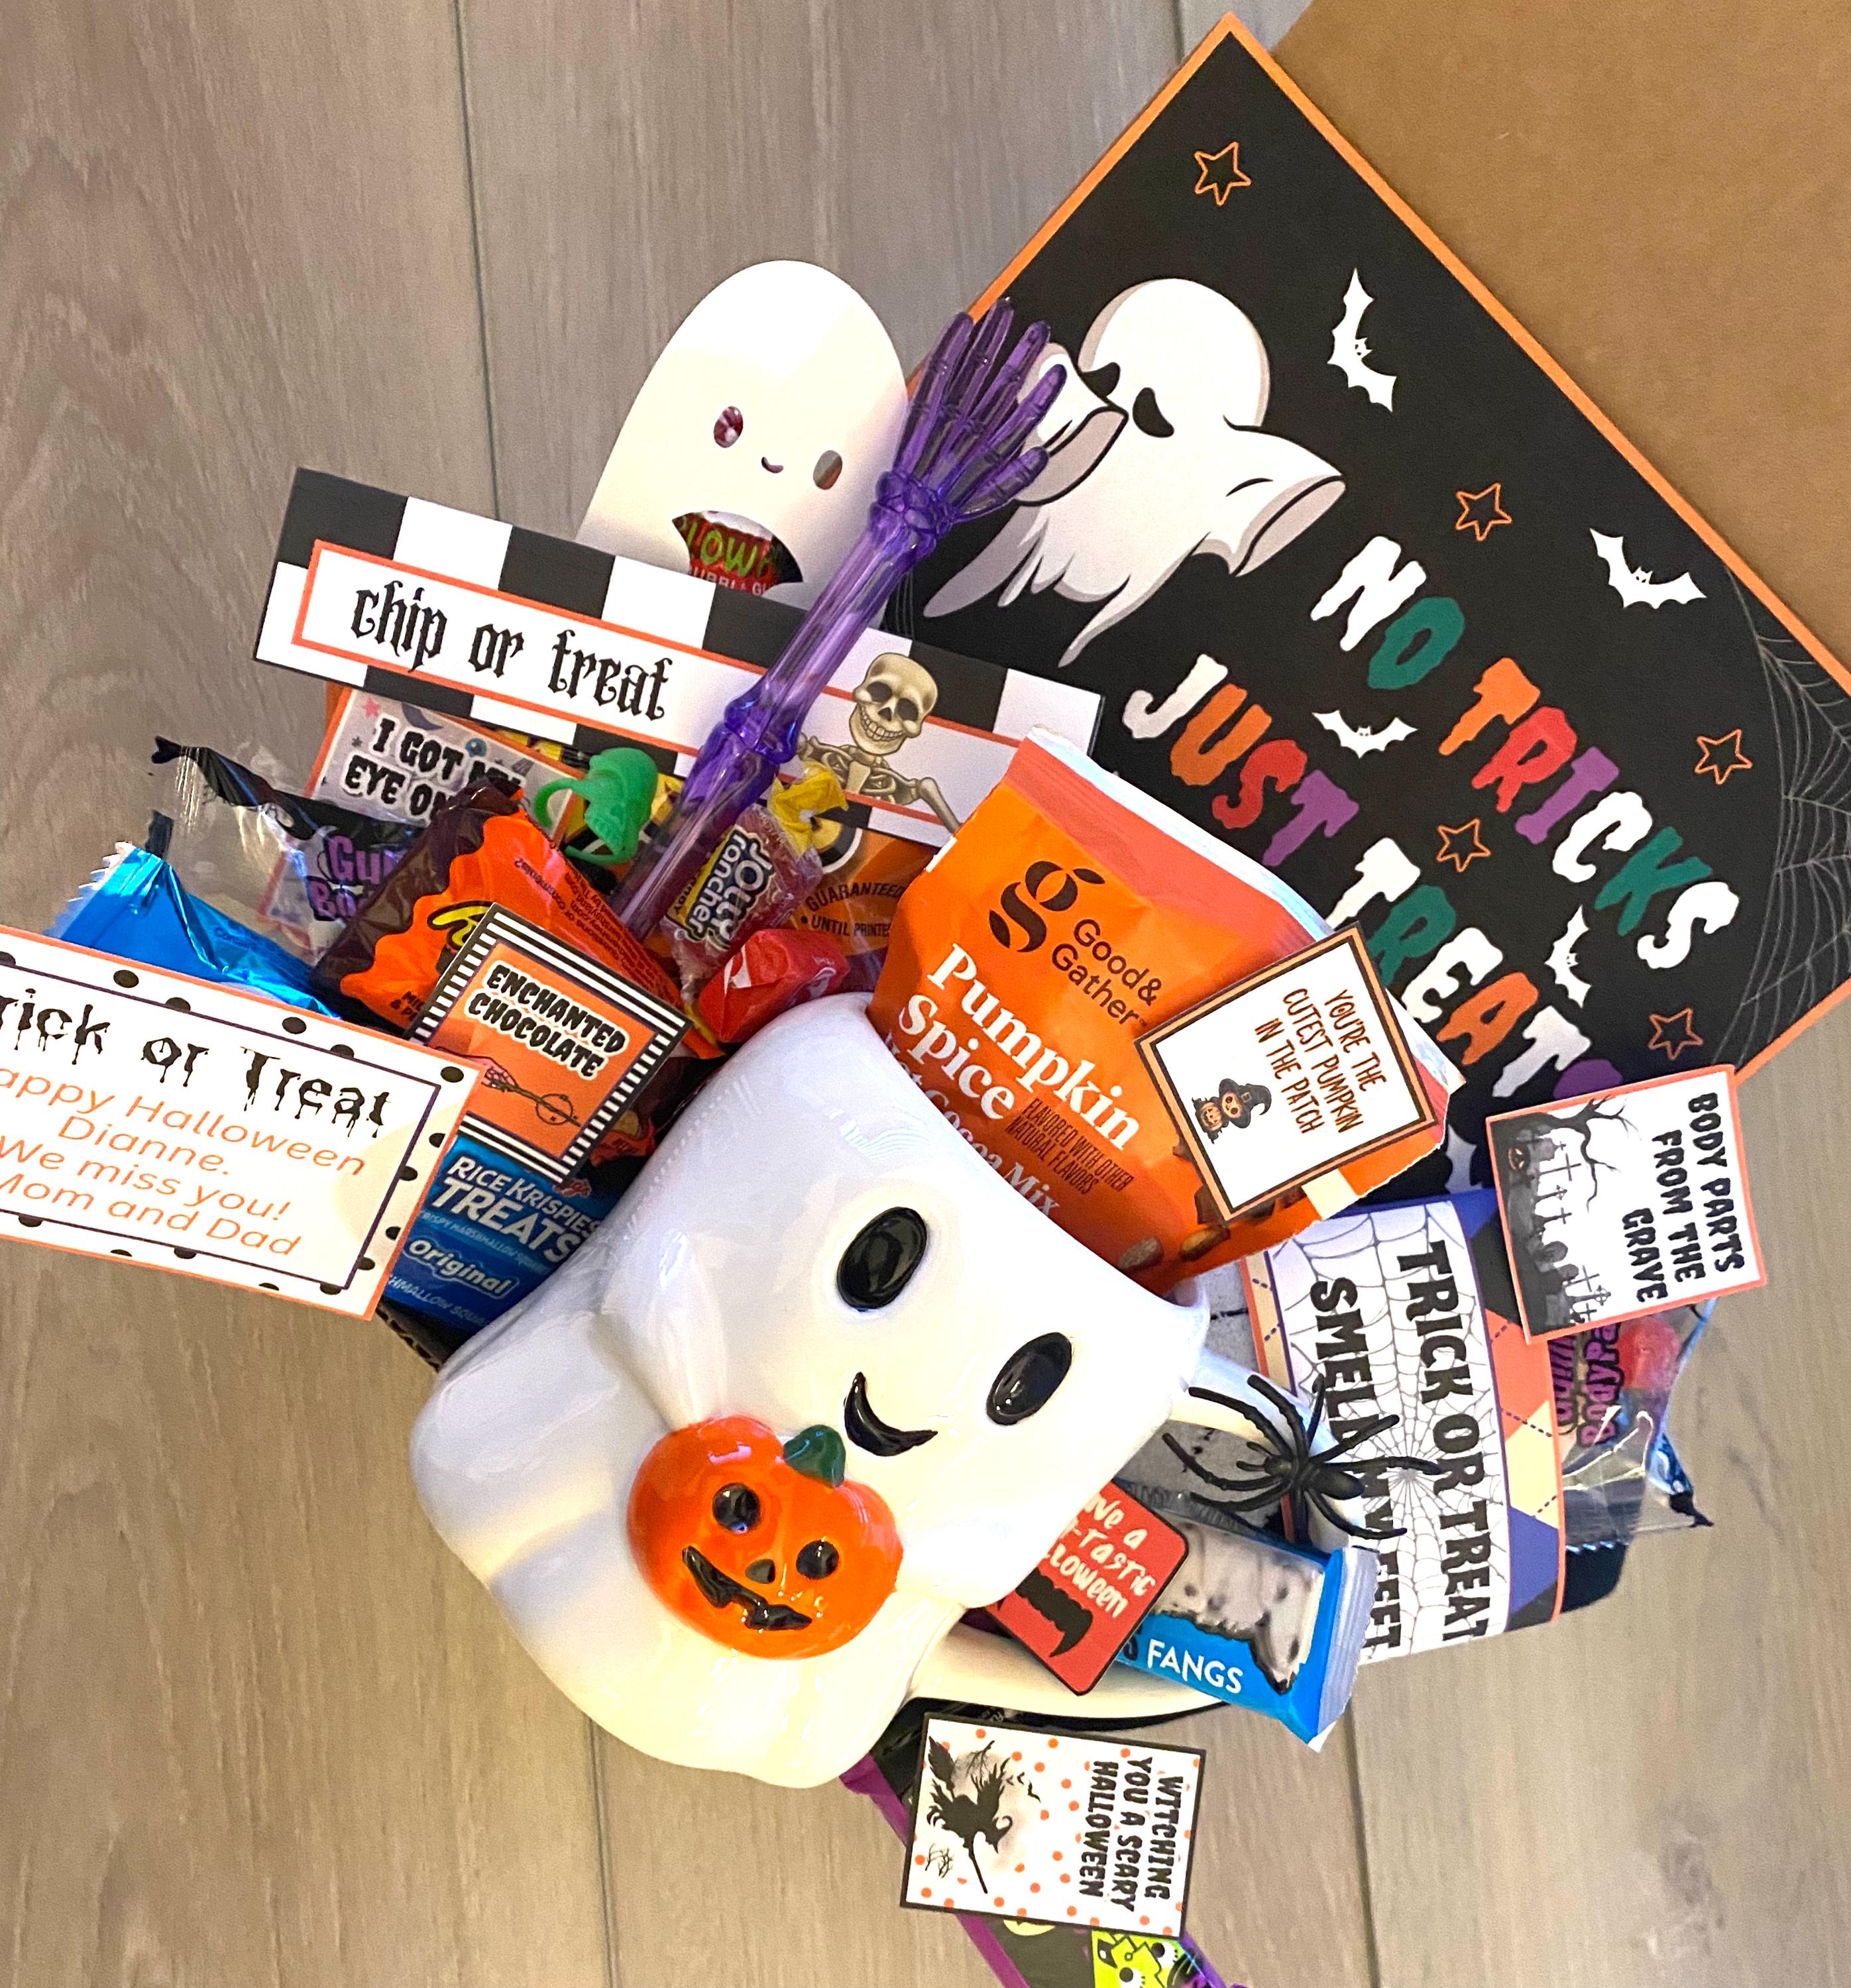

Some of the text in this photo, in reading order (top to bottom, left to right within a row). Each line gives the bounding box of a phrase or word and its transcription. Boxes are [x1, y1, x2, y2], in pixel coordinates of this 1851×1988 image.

[351, 580, 673, 721] chip or treat
[345, 754, 406, 804] EYE
[372, 718, 396, 753] I
[399, 730, 464, 781] GOT
[1122, 655, 1359, 866] JUST
[1311, 535, 1739, 969] NO TRICKS
[813, 915, 891, 938] UNTIL PRINTE
[1074, 919, 1162, 1006] Good&
[468, 993, 606, 1078] CHOCOLATE
[486, 964, 626, 1054] ENCHANTED
[926, 944, 1140, 1152] Pumpkin
[1325, 989, 1386, 1091] YOU'RE THE
[141, 1037, 209, 1087] or
[240, 1046, 391, 1138] Treat
[898, 994, 1015, 1121] Spice
[1255, 1018, 1325, 1134] IN THE PATCH
[1283, 989, 1363, 1133] CUTEST PUMPKIN
[0, 1068, 365, 1176] appy Halloween
[58, 1115, 229, 1176] Dianne.
[1021, 1097, 1135, 1191] FLAVORED WITH OTHER
[0, 1135, 292, 1221] We miss you!
[432, 1177, 582, 1263] TREATS
[447, 1156, 512, 1191] RICE
[506, 1178, 601, 1239] KRISPIES
[1004, 1160, 1060, 1217] Mix
[1652, 1129, 1706, 1282] FROM THE
[1688, 1092, 1744, 1272] BODY PARTS
[108, 1201, 200, 1231] and
[206, 1217, 302, 1256] Dad
[409, 1239, 514, 1294] Original
[1622, 1207, 1668, 1302] GRAVE
[1396, 1239, 1491, 1641] TRICK OR TREAT
[1123, 1528, 1148, 1549] a
[1147, 1638, 1244, 1694] FANGS
[1079, 1761, 1119, 1897] HALLOWEEN
[1110, 1757, 1152, 1912] YOU A SCARY
[1144, 1776, 1184, 1899] WITCHING
